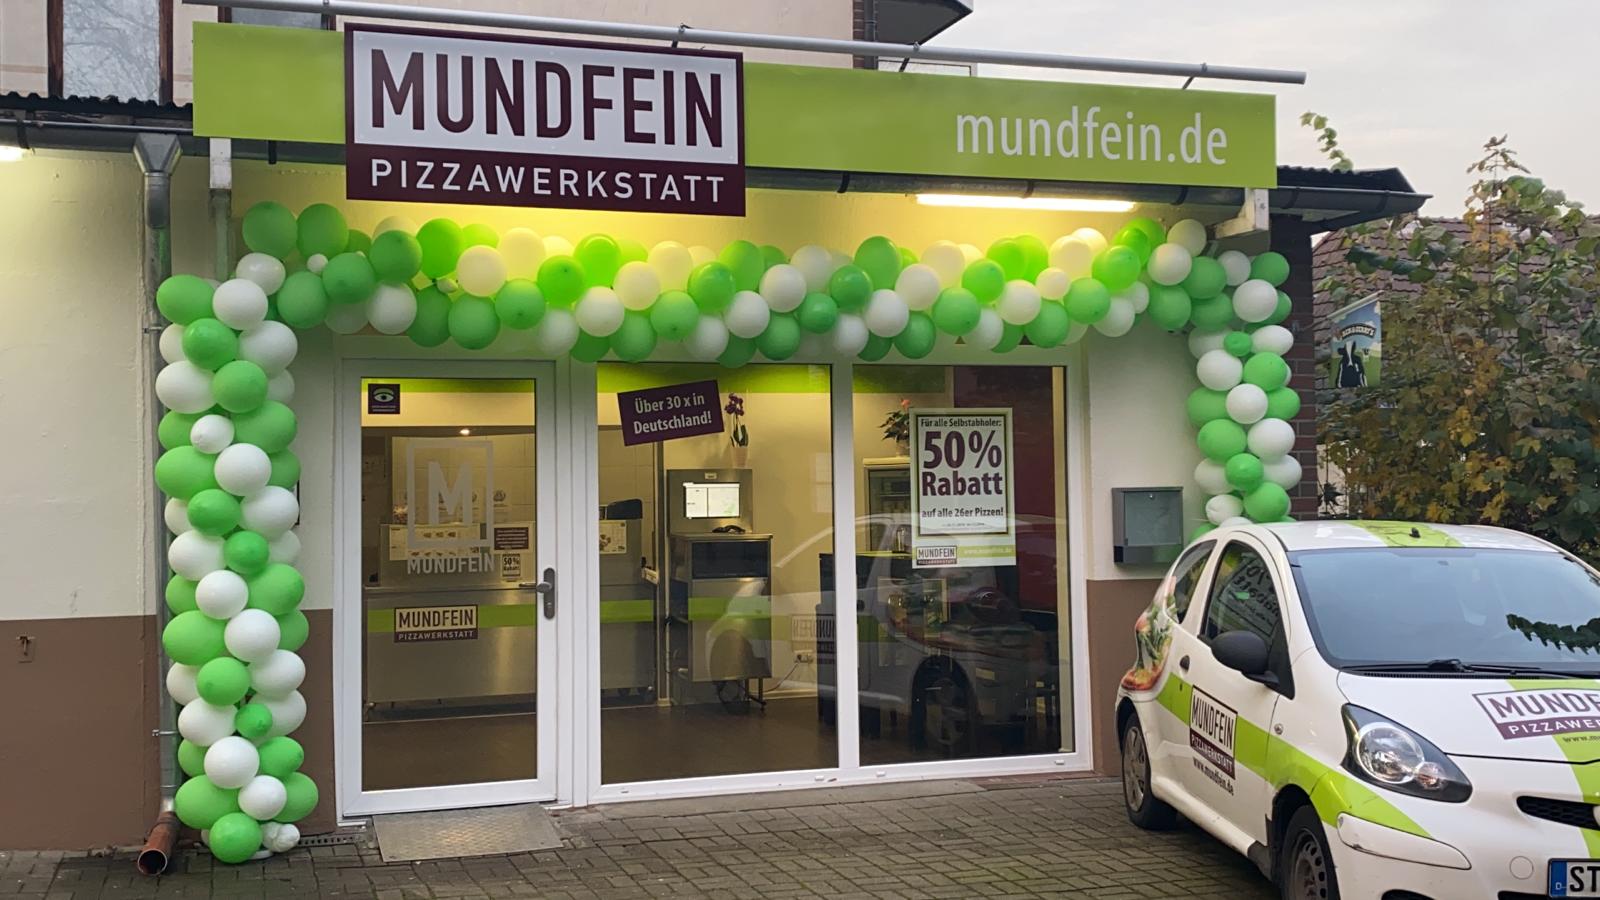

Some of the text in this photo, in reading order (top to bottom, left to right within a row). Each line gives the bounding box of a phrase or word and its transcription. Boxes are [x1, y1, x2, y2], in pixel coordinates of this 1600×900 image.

[371, 48, 723, 148] MUNDFEIN
[956, 105, 1228, 165] mundfein.de
[371, 158, 724, 203] PIZZAWERKSTATT
[635, 392, 705, 414] Über 30 x in
[633, 410, 712, 435] Deutschland!
[921, 417, 1002, 428] Für alle Selbstabholer:
[923, 430, 1002, 469] 50%
[428, 460, 473, 528] M
[922, 471, 1003, 496] Rabatt
[922, 507, 1004, 518] auf alle 26er Pizzen!
[407, 553, 495, 575] MUNDFEIN
[918, 549, 955, 559] MUNDFEIN
[399, 608, 474, 628] MUNDFEIN
[399, 630, 474, 641] PIZZAWERKSTATT
[1191, 694, 1235, 750] MUNDFEIN
[1569, 865, 1600, 892] ST
